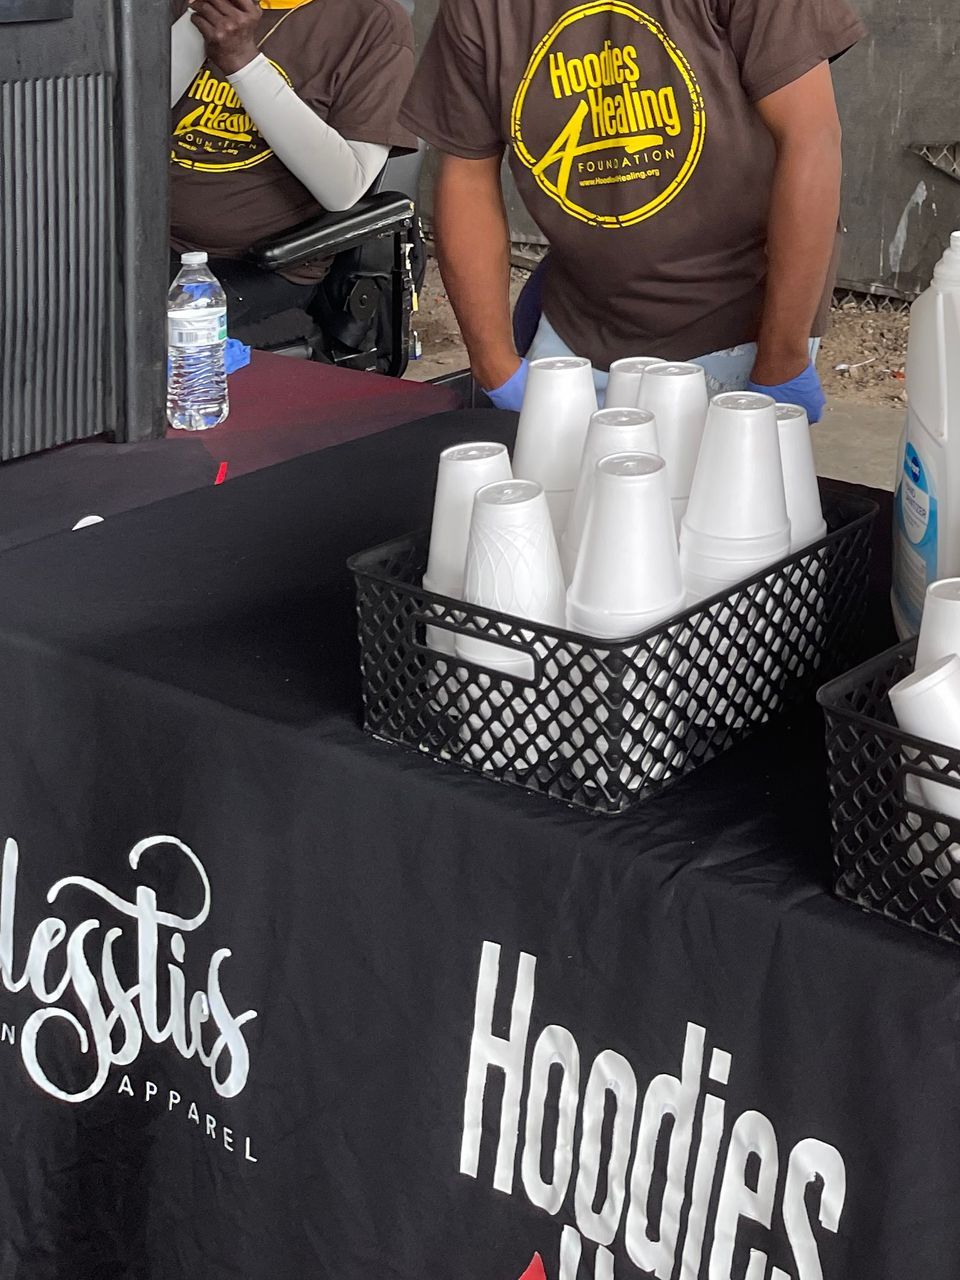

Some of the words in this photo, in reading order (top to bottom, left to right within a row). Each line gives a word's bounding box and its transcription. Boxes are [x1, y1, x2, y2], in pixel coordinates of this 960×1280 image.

[549, 40, 641, 99] Hoodies
[586, 81, 683, 137] Healing
[577, 148, 676, 173] FOUNDATION
[117, 1074, 258, 1163] APPAREL
[459, 940, 847, 1280] Hoodies
